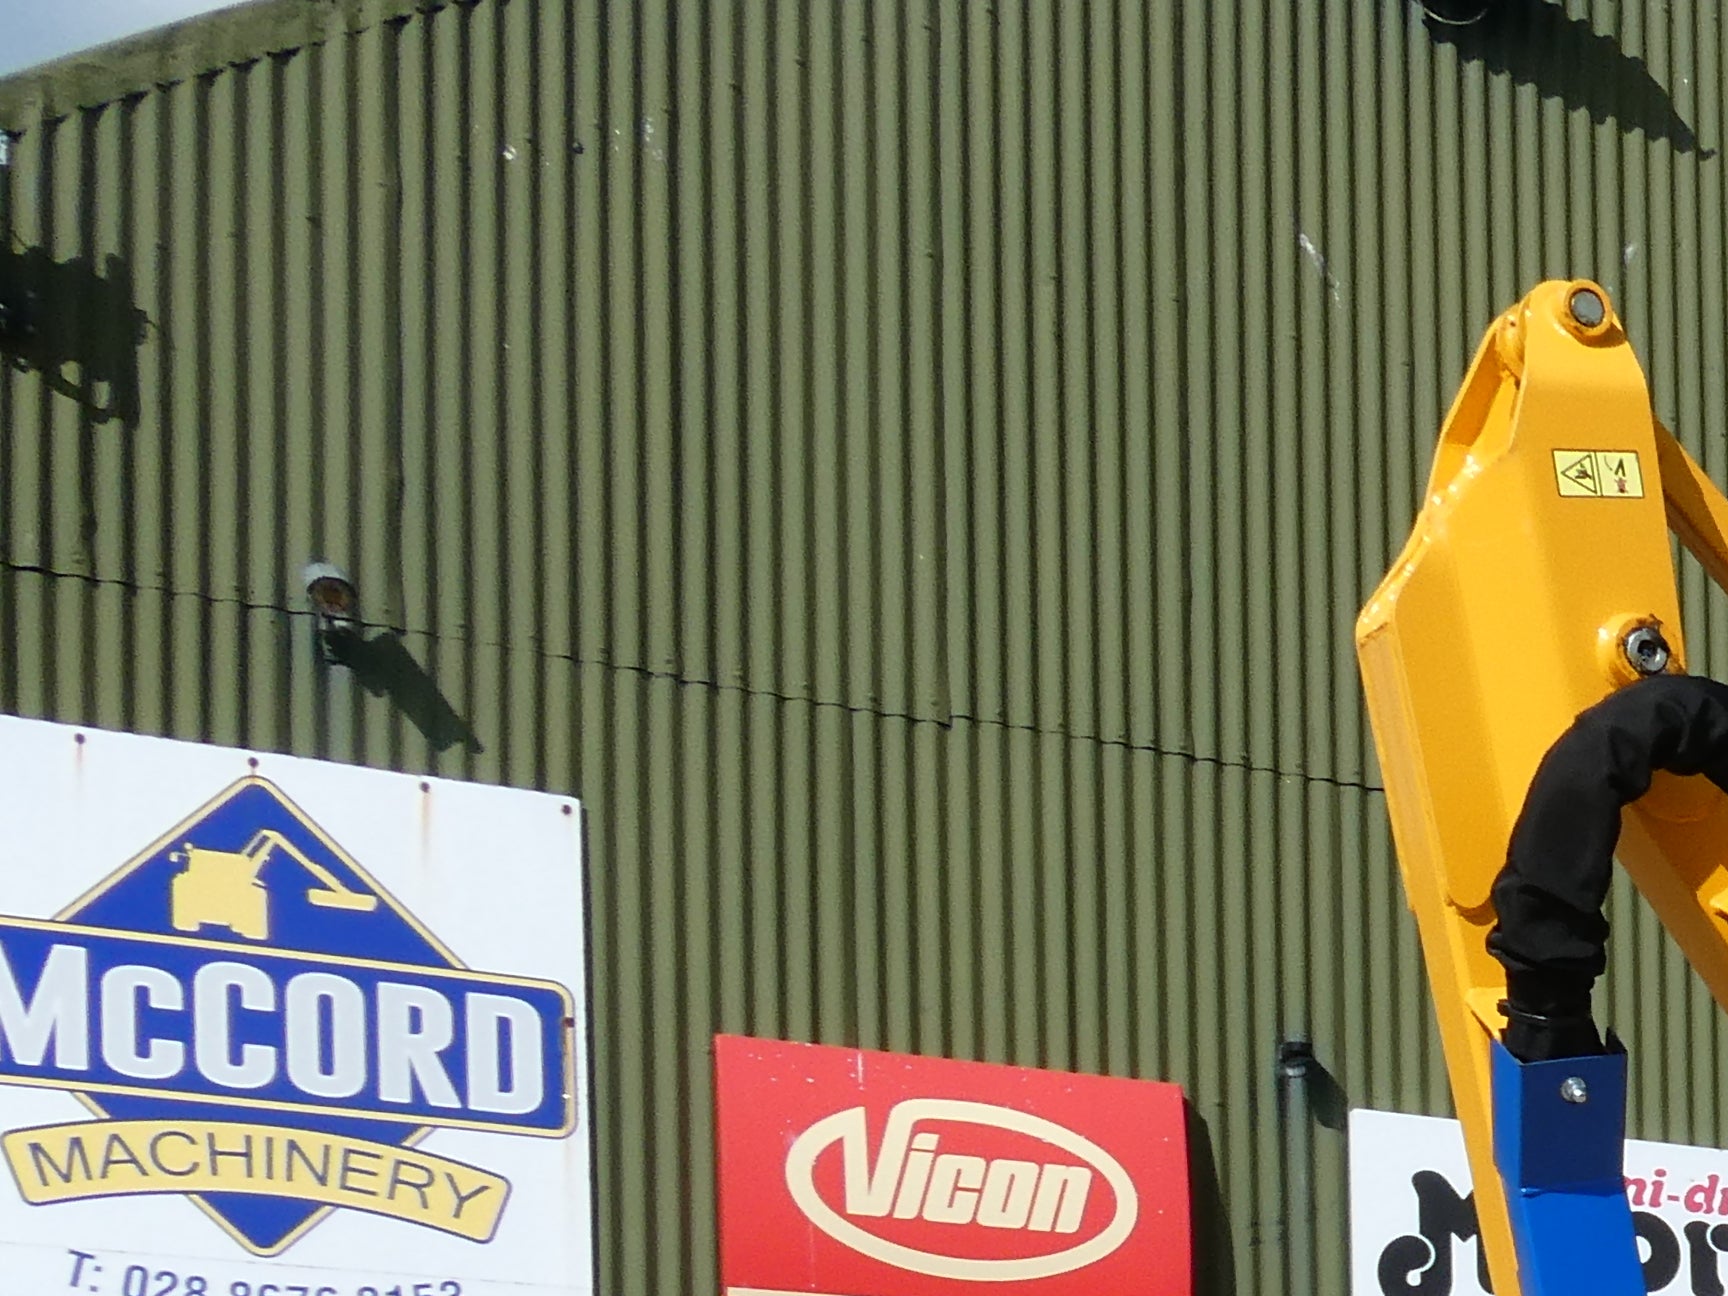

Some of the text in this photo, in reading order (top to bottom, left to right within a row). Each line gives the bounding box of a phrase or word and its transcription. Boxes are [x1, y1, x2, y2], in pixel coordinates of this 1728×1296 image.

[28, 1130, 492, 1221] MACHINERY
[842, 1105, 1092, 1234] Vicon
[68, 1248, 103, 1293] T:
